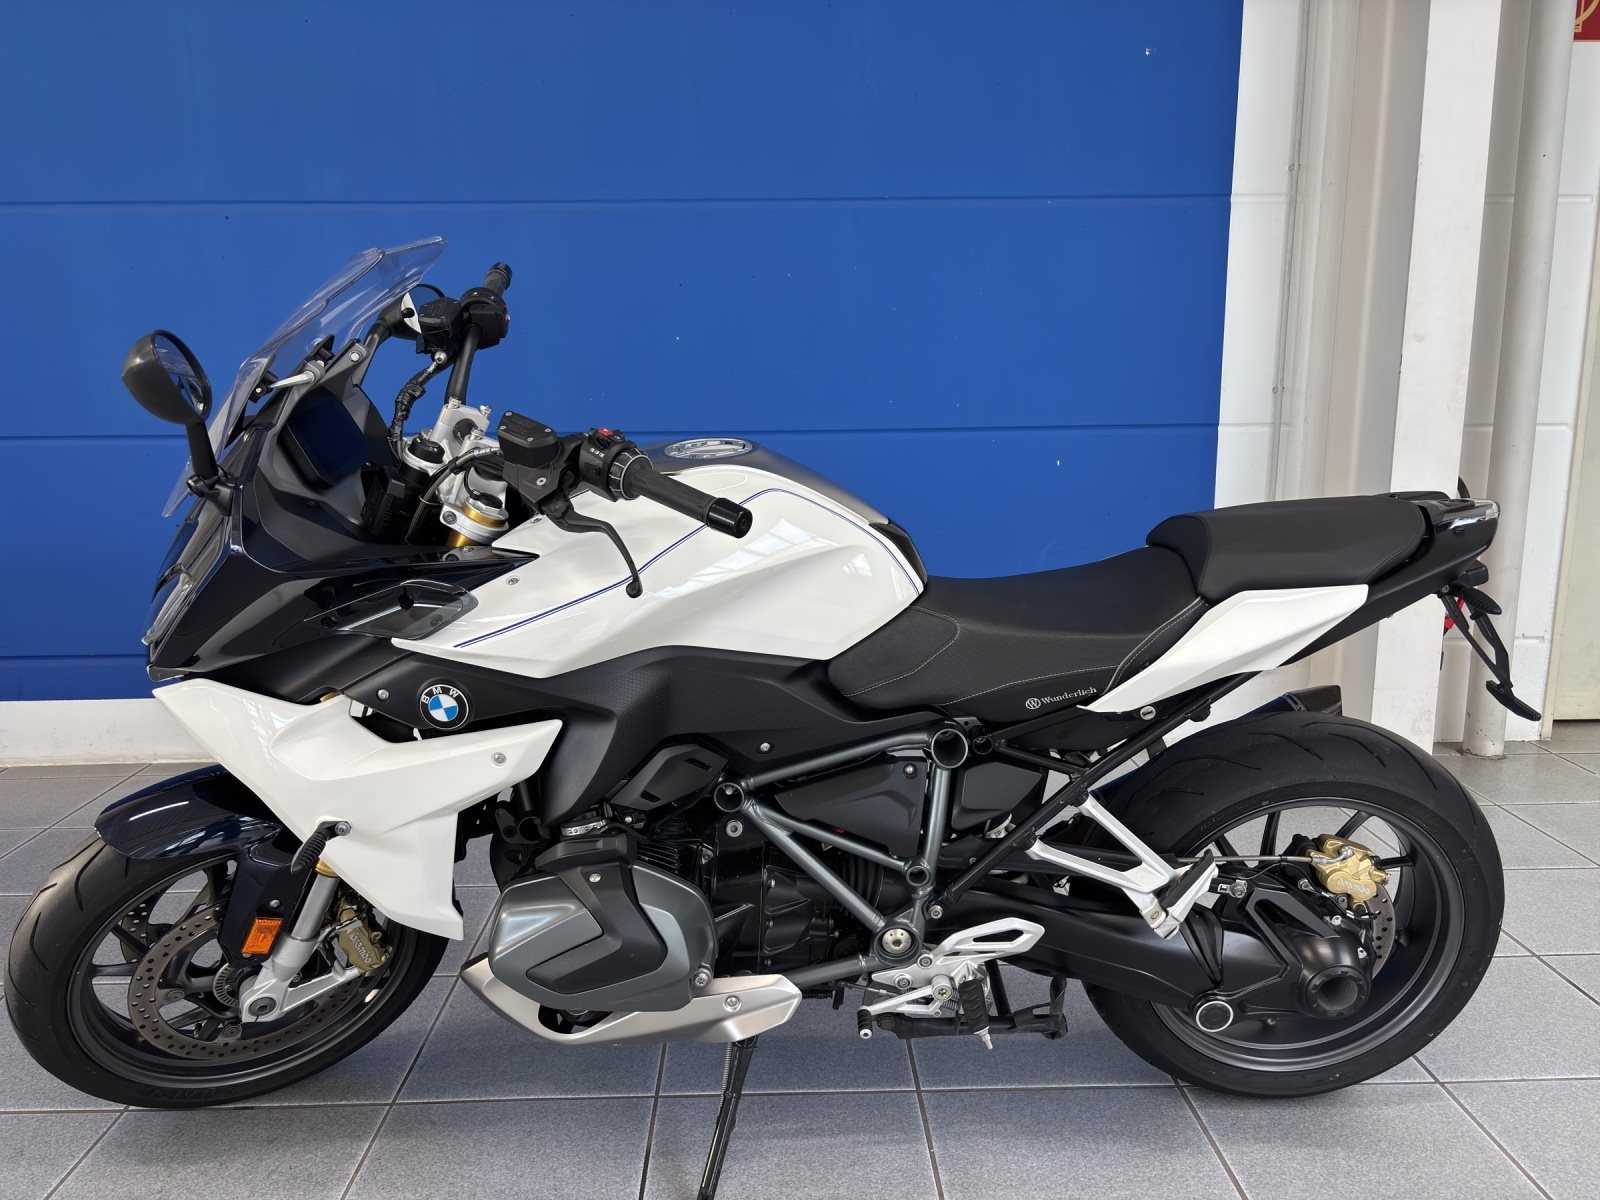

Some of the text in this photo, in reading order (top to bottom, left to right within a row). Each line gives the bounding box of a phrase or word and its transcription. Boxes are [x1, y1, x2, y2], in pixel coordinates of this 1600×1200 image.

[421, 686, 460, 704] BMW
[1041, 686, 1097, 705] Wunderlich
[350, 931, 372, 964] brembo
